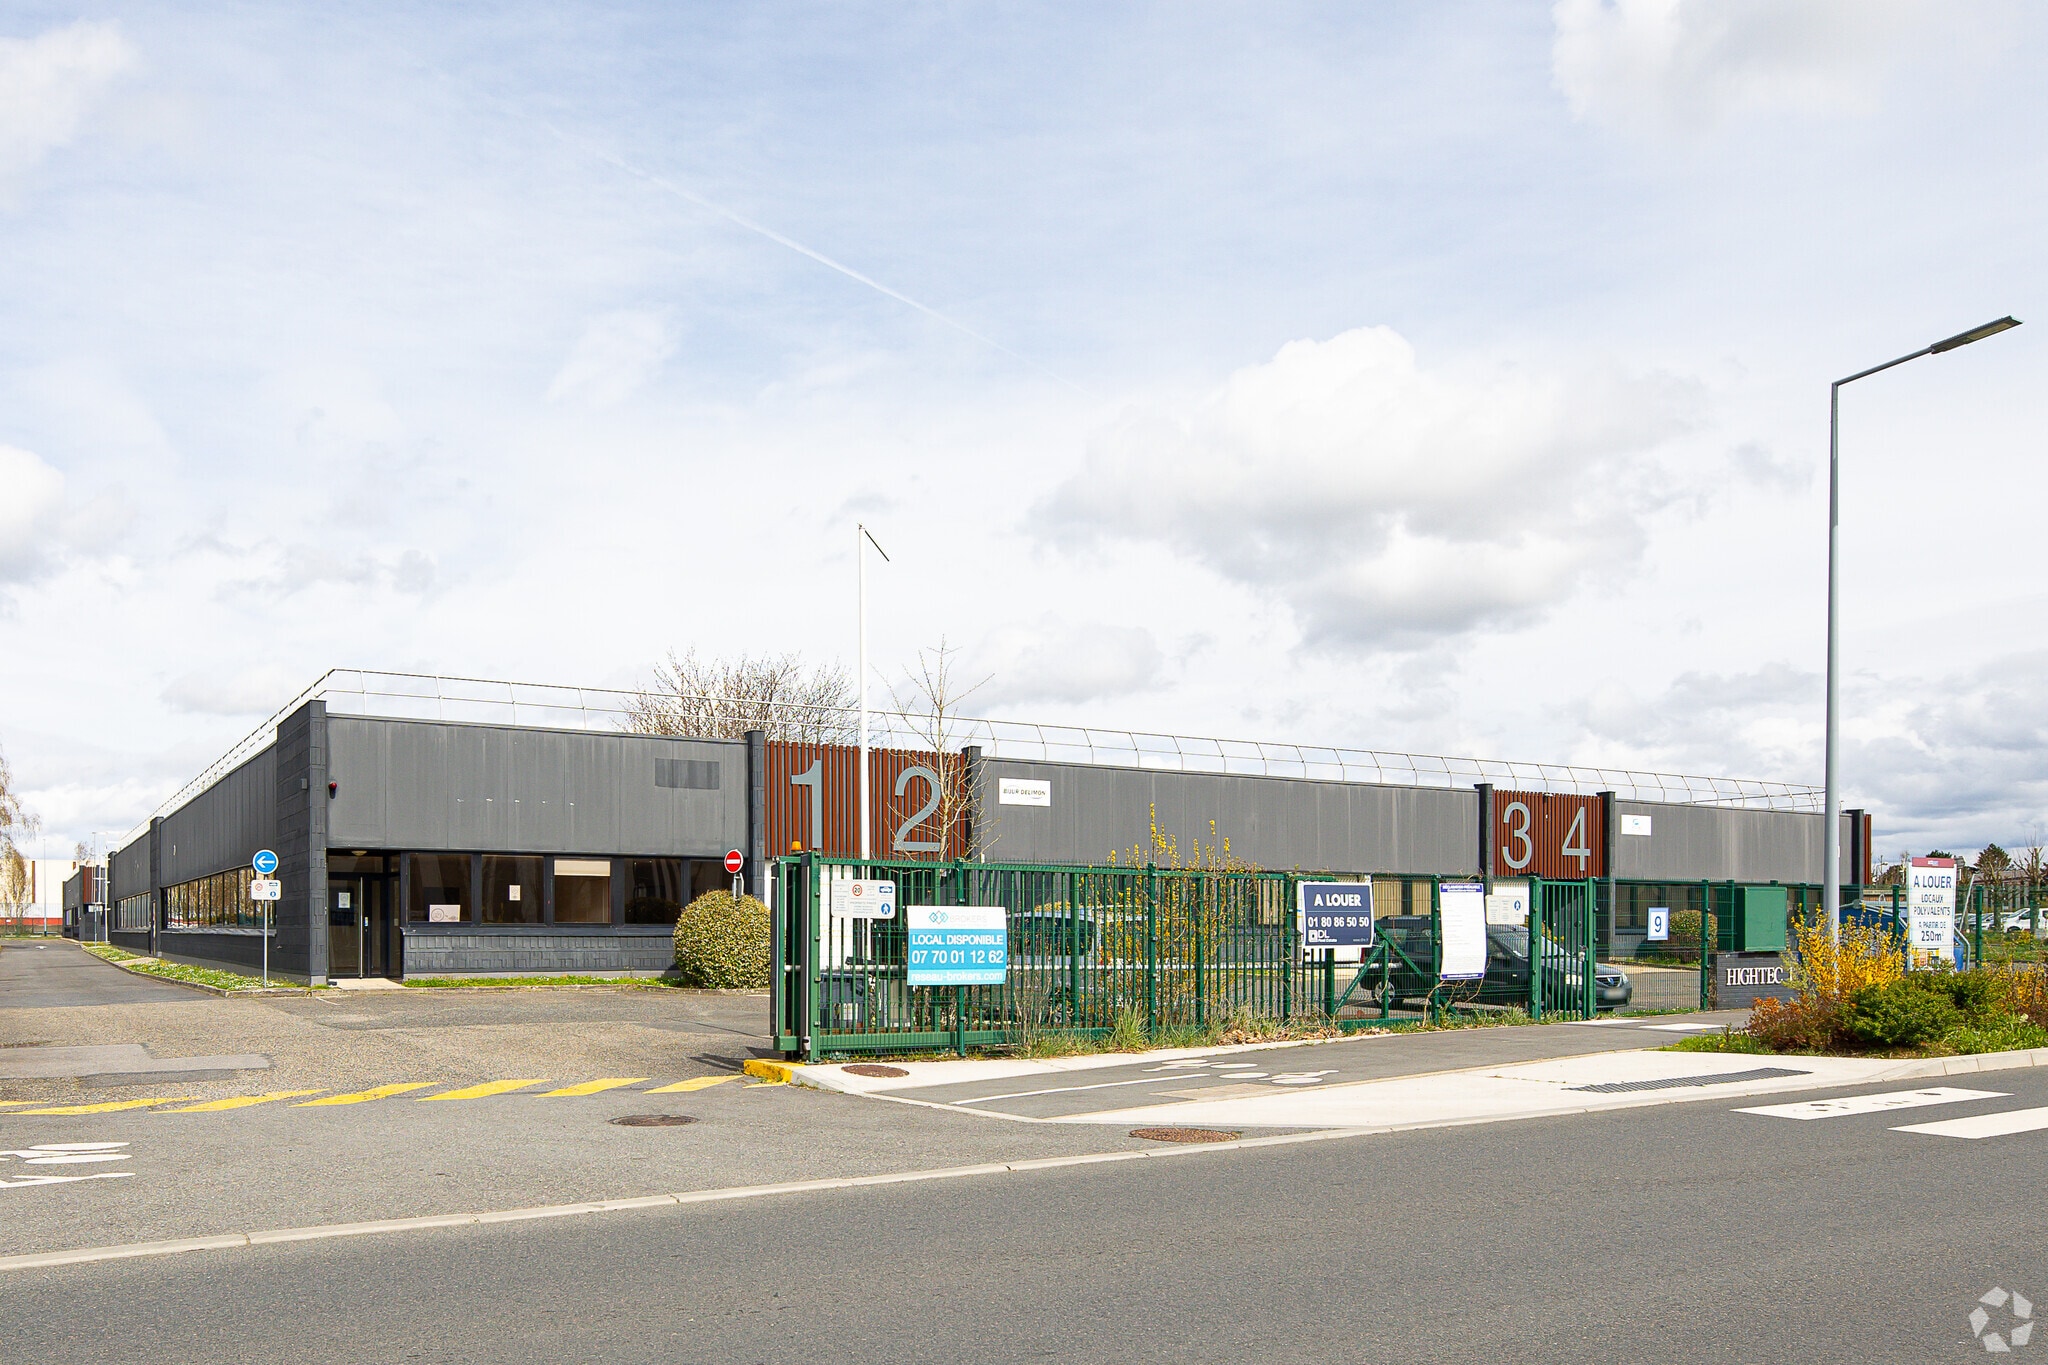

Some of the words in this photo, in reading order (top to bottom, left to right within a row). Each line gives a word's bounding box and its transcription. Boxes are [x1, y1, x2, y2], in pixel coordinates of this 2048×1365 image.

[791, 759, 822, 848] 1
[894, 766, 941, 851] 2
[1502, 801, 1532, 869] 3
[1562, 806, 1590, 871] 4
[1913, 875, 1920, 887] A
[1922, 875, 1951, 888] LOUER
[1314, 893, 1324, 907] A
[1325, 893, 1362, 907] LOUER
[1921, 894, 1944, 904] LOCAUX
[1914, 906, 1951, 916] POLYVALENTS
[1308, 916, 1318, 928] 01
[1320, 916, 1332, 928] 80
[1333, 916, 1345, 928] 86
[1346, 916, 1357, 928] 50
[1358, 916, 1370, 928] 50
[1654, 915, 1662, 933] 9
[912, 934, 945, 945] LOCAL
[946, 934, 1004, 945] DISPONIBLE
[911, 950, 928, 964] 07
[931, 950, 948, 964] 70
[950, 950, 965, 964] 01
[970, 950, 986, 964] 12
[988, 950, 1004, 964] 62
[911, 971, 1003, 982] reseau-brokers.com
[1726, 966, 1784, 986] HIGHTEC
